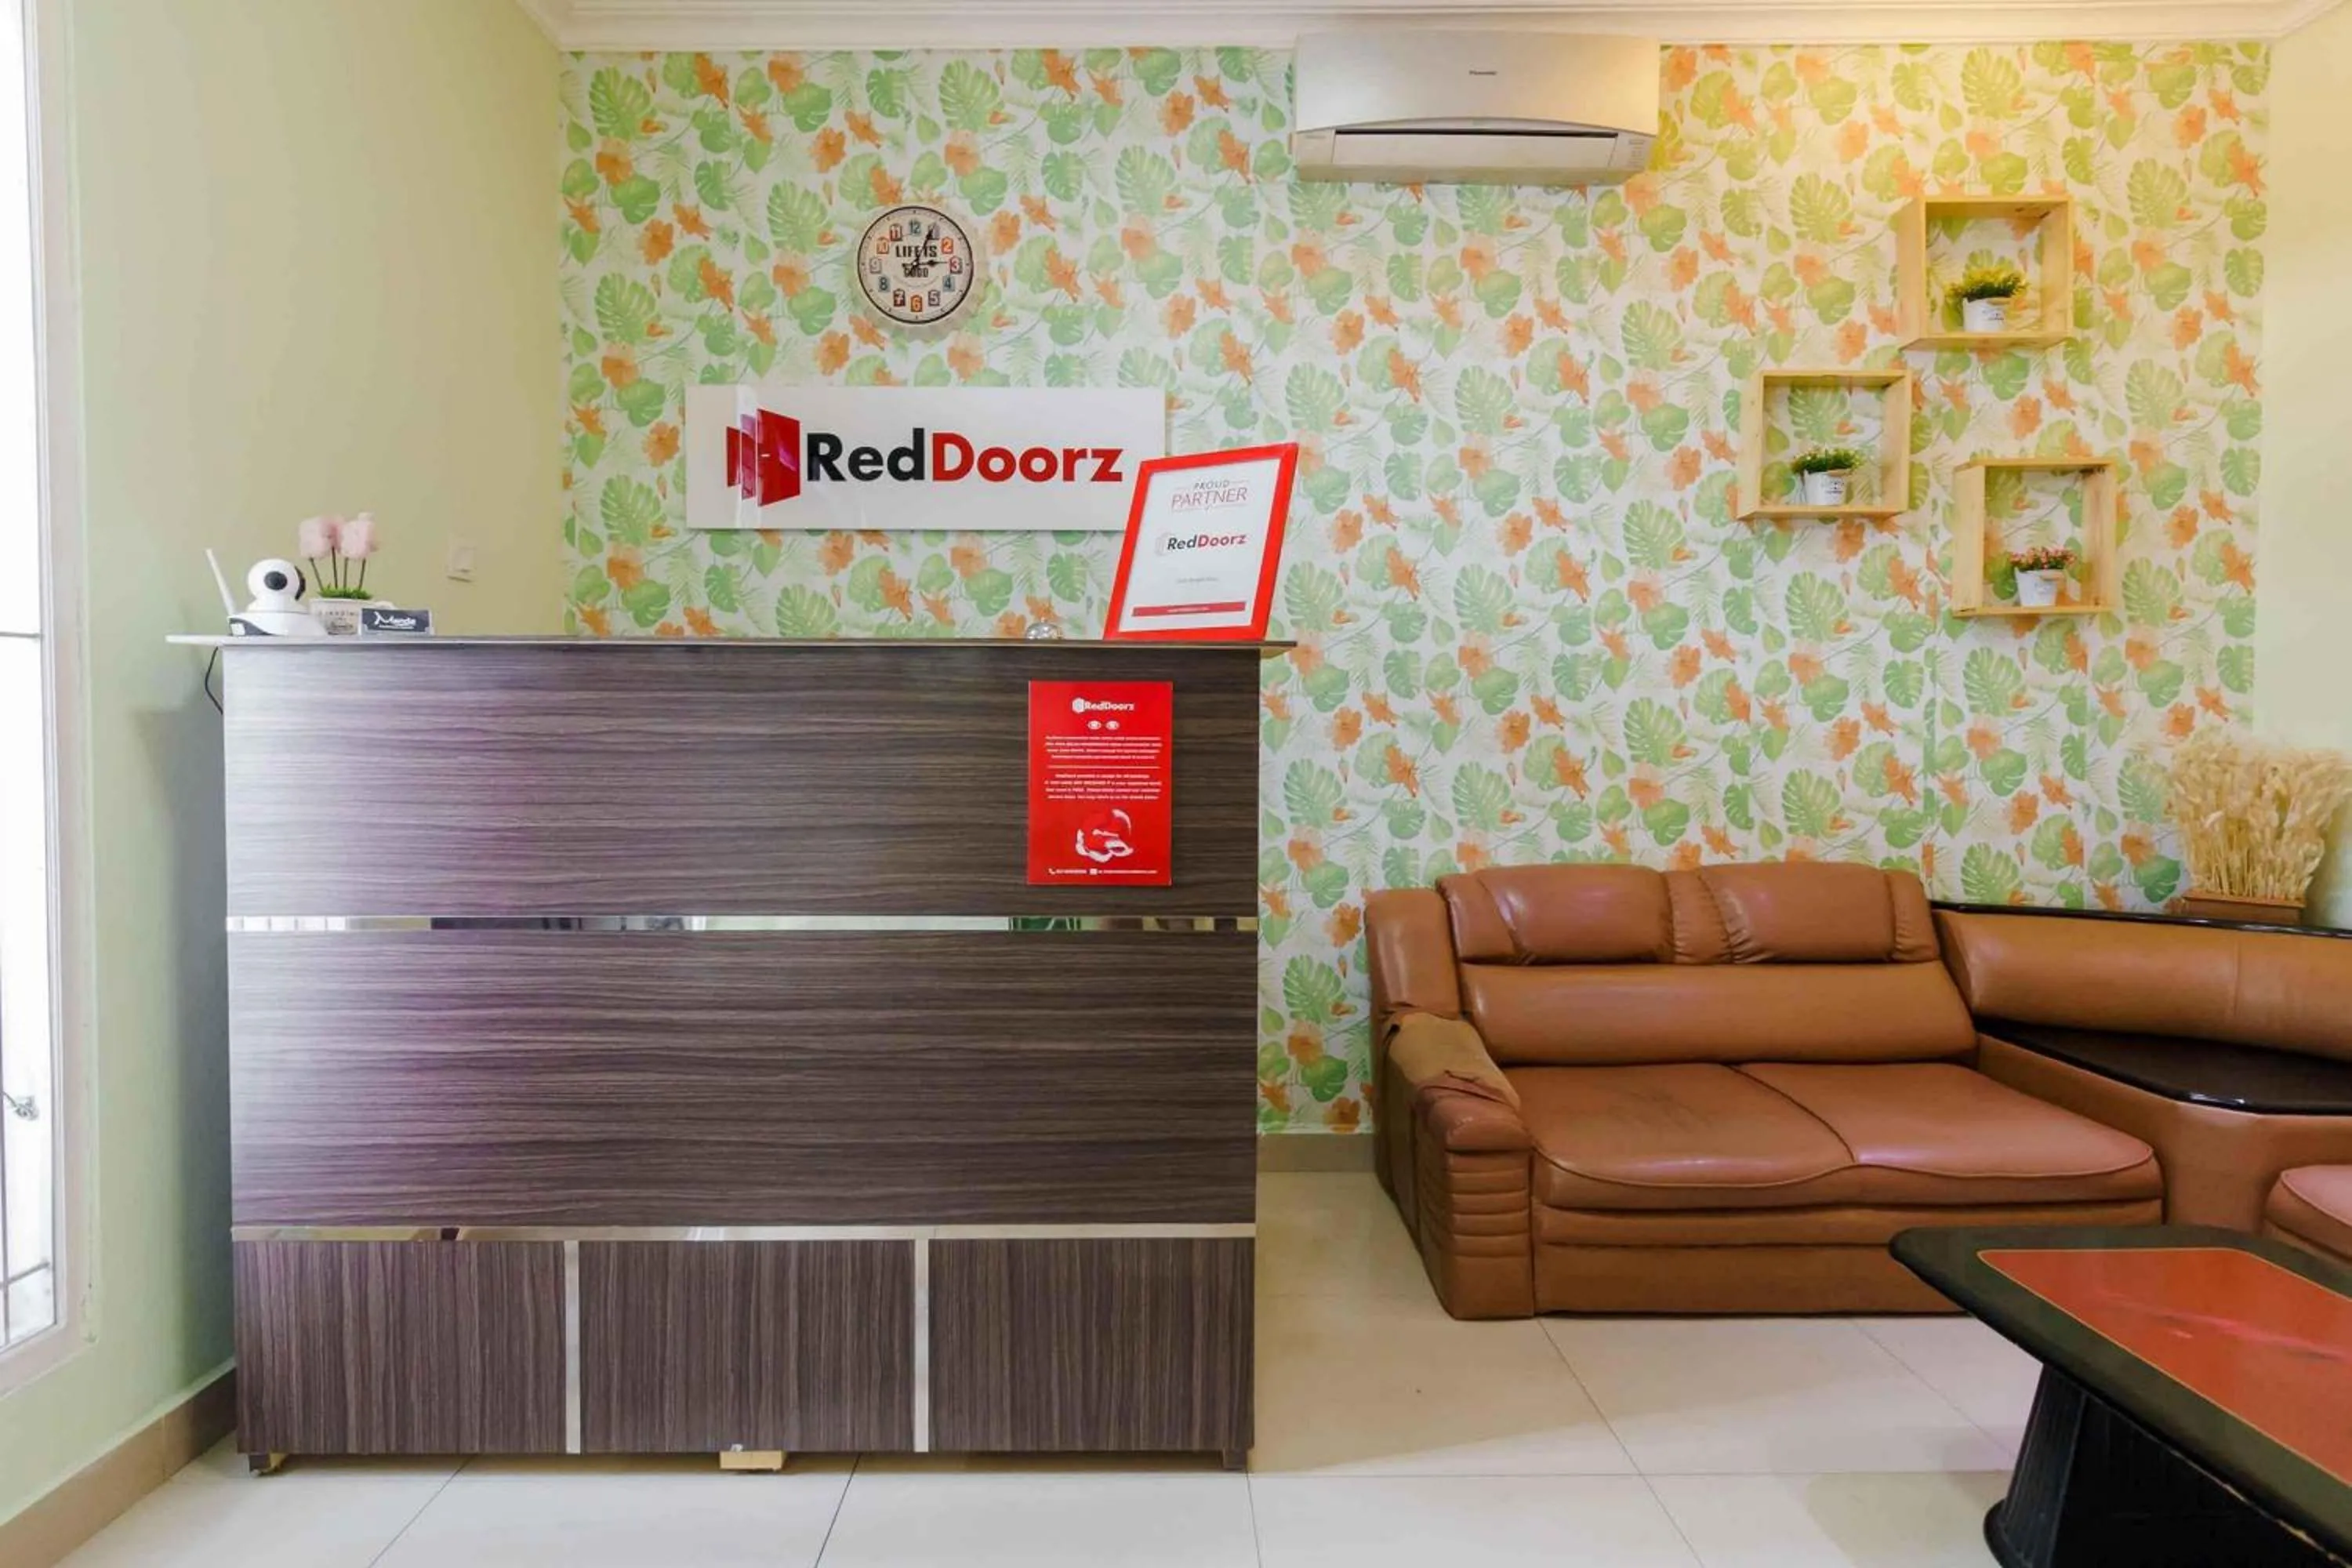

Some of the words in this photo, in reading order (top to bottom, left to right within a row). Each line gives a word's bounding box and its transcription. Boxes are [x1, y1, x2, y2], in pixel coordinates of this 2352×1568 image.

[909, 220, 920, 234] 12
[895, 245, 921, 258] LIFE
[924, 245, 938, 258] IS
[880, 277, 887, 290] 8
[944, 277, 951, 289] 4
[912, 298, 920, 311] 6
[930, 292, 938, 304] 5
[807, 427, 1123, 482] RedDoorz
[1194, 480, 1230, 490] PROUD
[1171, 486, 1247, 508] PARTNER
[1167, 534, 1247, 550] RedDoorz
[1084, 701, 1135, 711] RedDoorz
